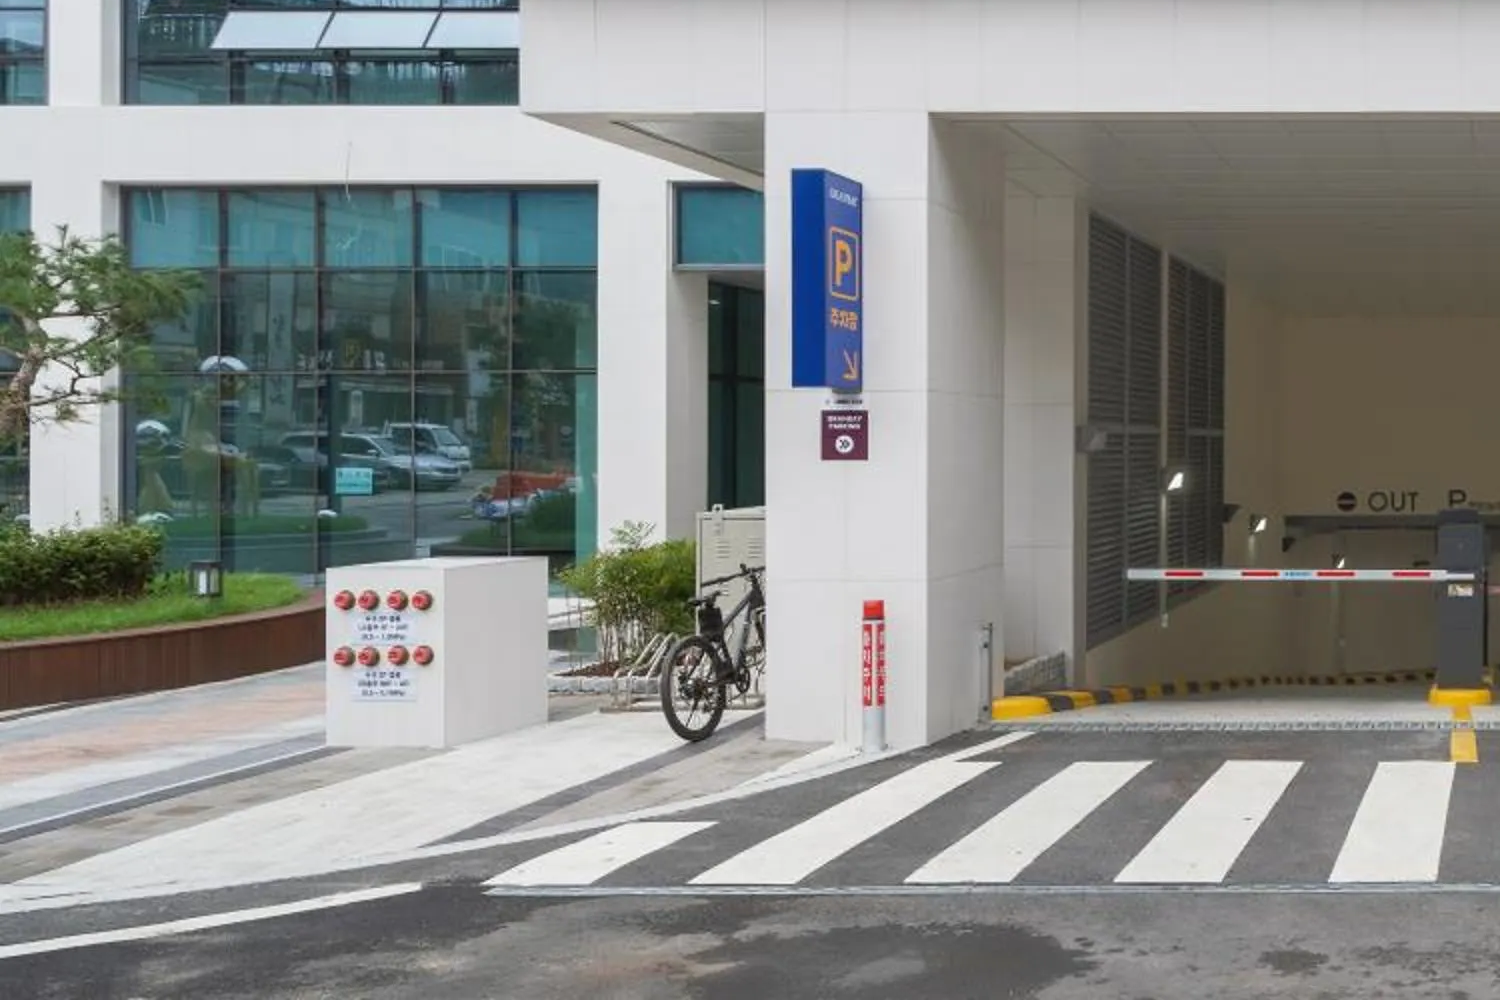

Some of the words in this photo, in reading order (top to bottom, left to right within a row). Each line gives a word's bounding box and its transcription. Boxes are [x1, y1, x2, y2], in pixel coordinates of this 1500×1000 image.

[835, 239, 853, 287] P
[1368, 490, 1419, 512] OUT
[1448, 489, 1467, 508] P
